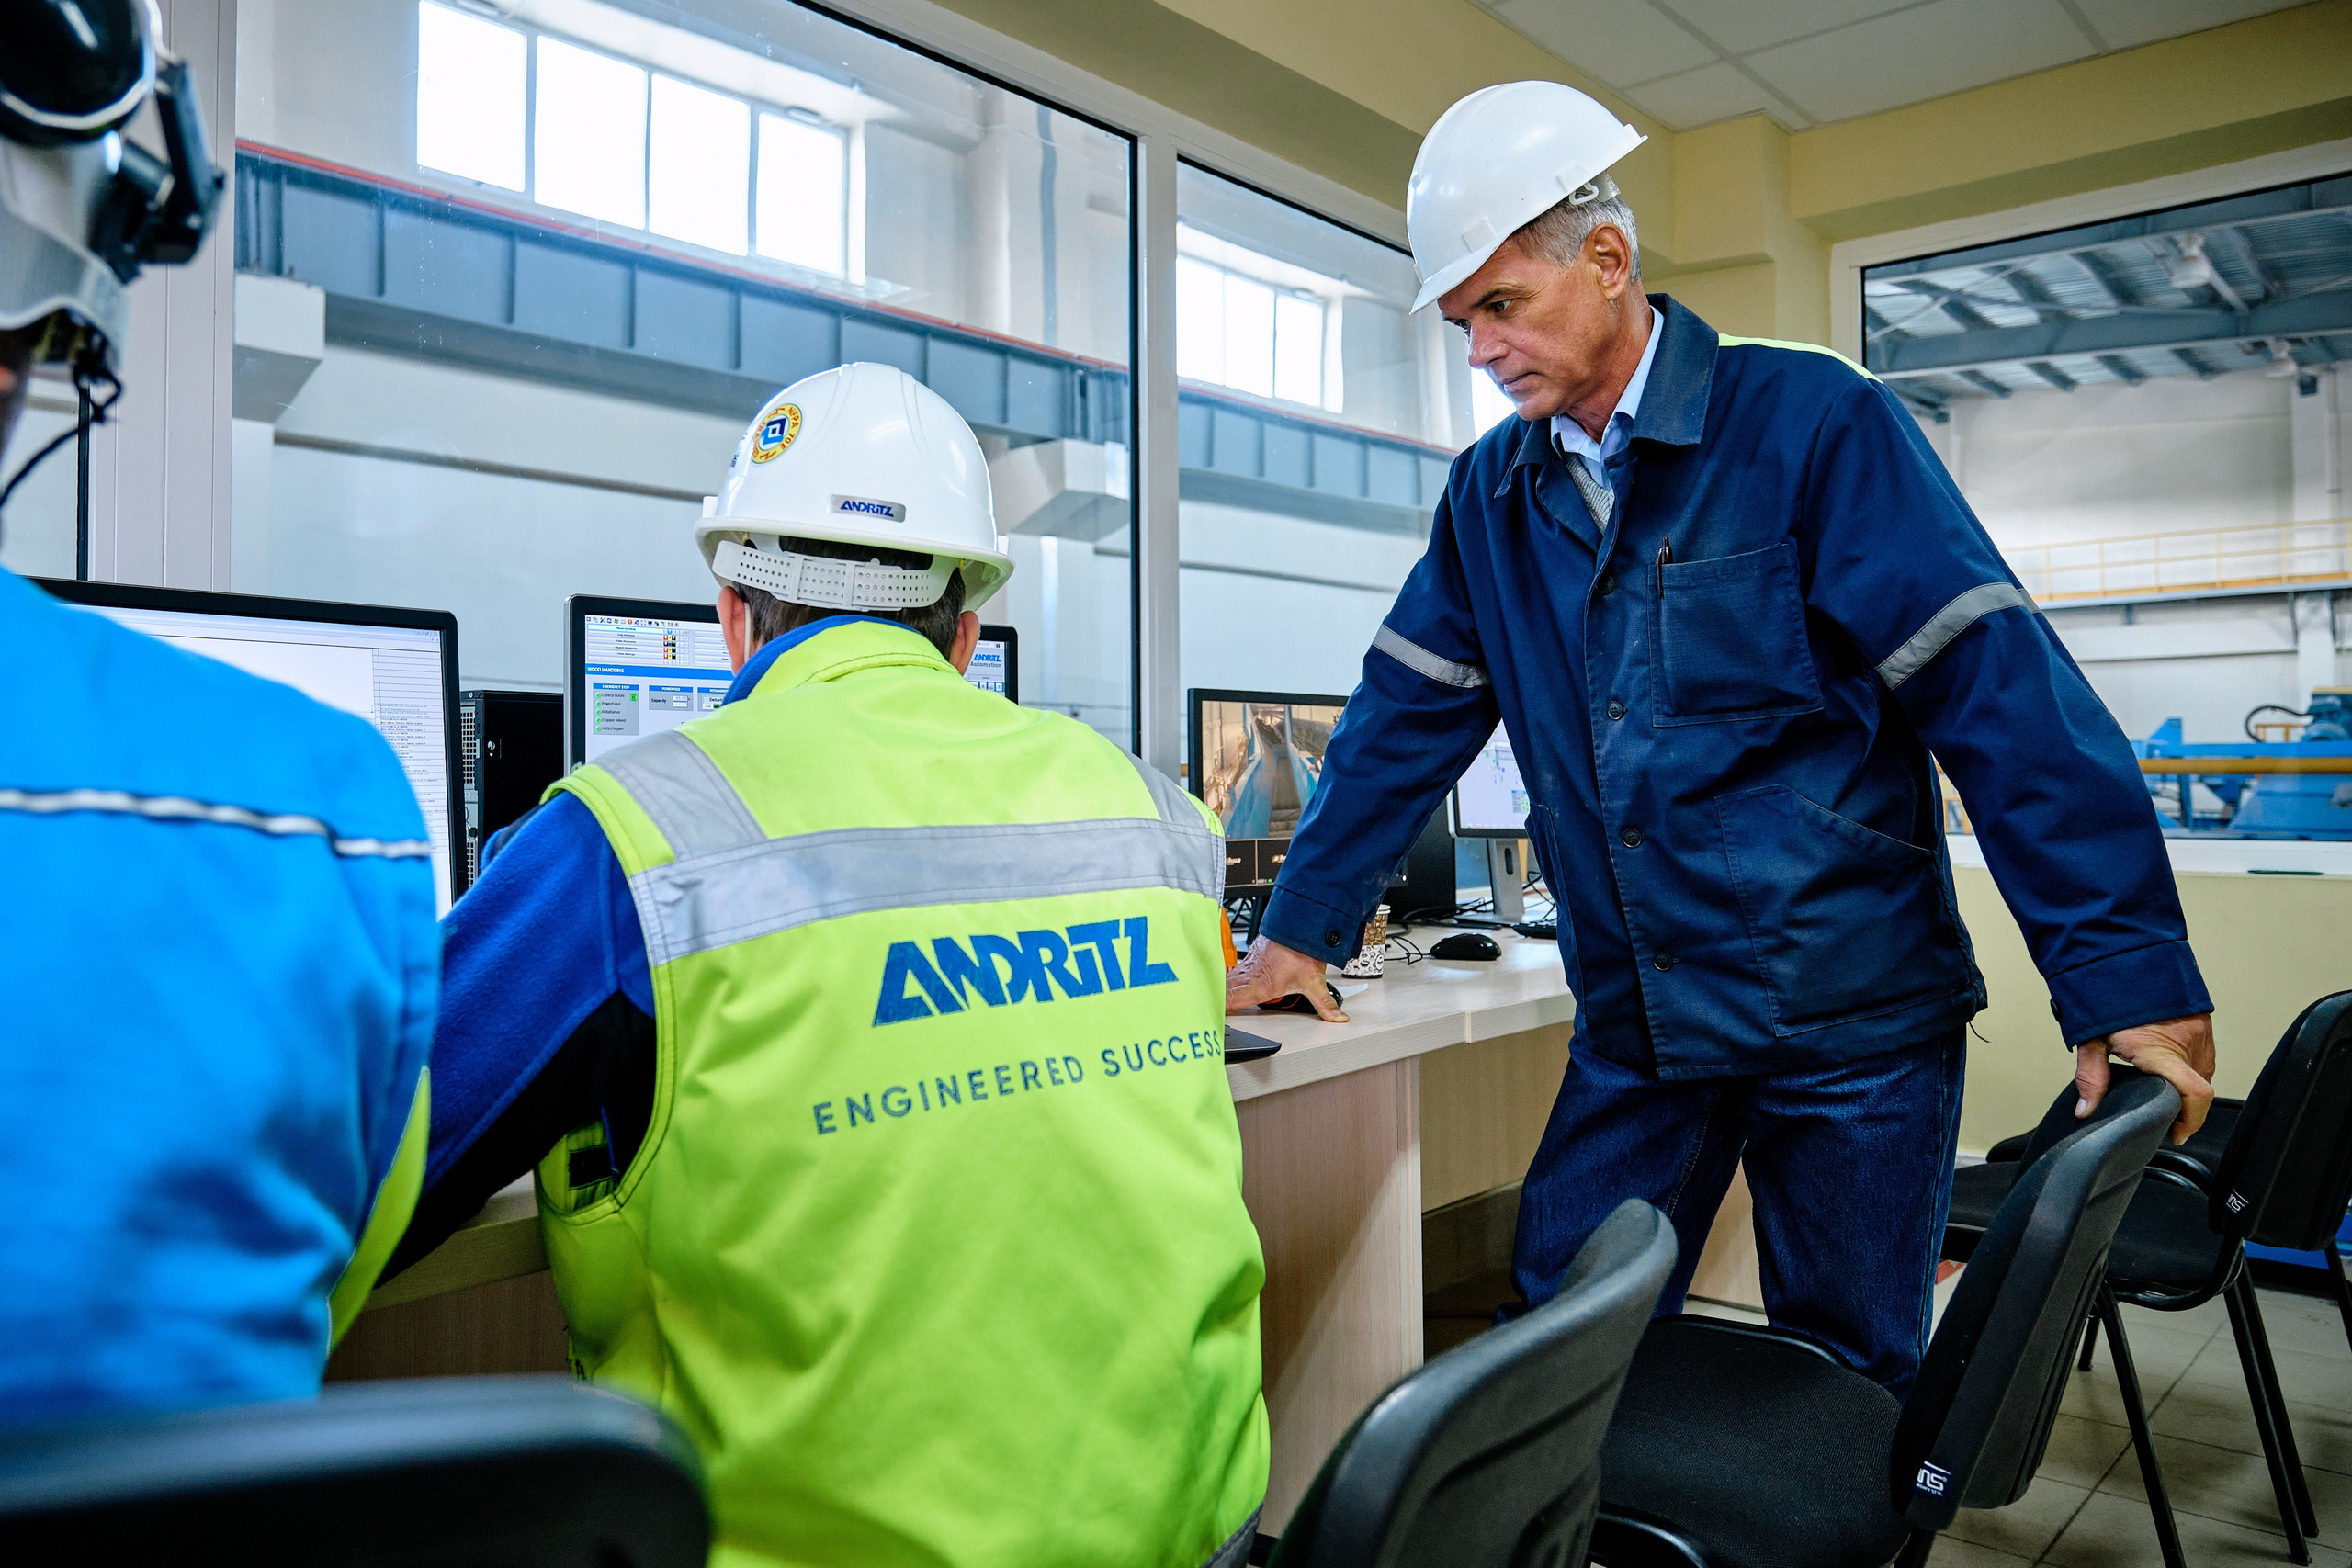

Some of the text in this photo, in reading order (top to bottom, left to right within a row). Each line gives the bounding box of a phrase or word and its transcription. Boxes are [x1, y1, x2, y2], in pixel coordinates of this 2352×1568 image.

[786, 406, 799, 429] NFPA
[840, 500, 894, 517] ANDRITZ
[872, 916, 1179, 1027] ANDRITZ
[813, 1030, 1222, 1134] ENGINEERED SUCCESS
